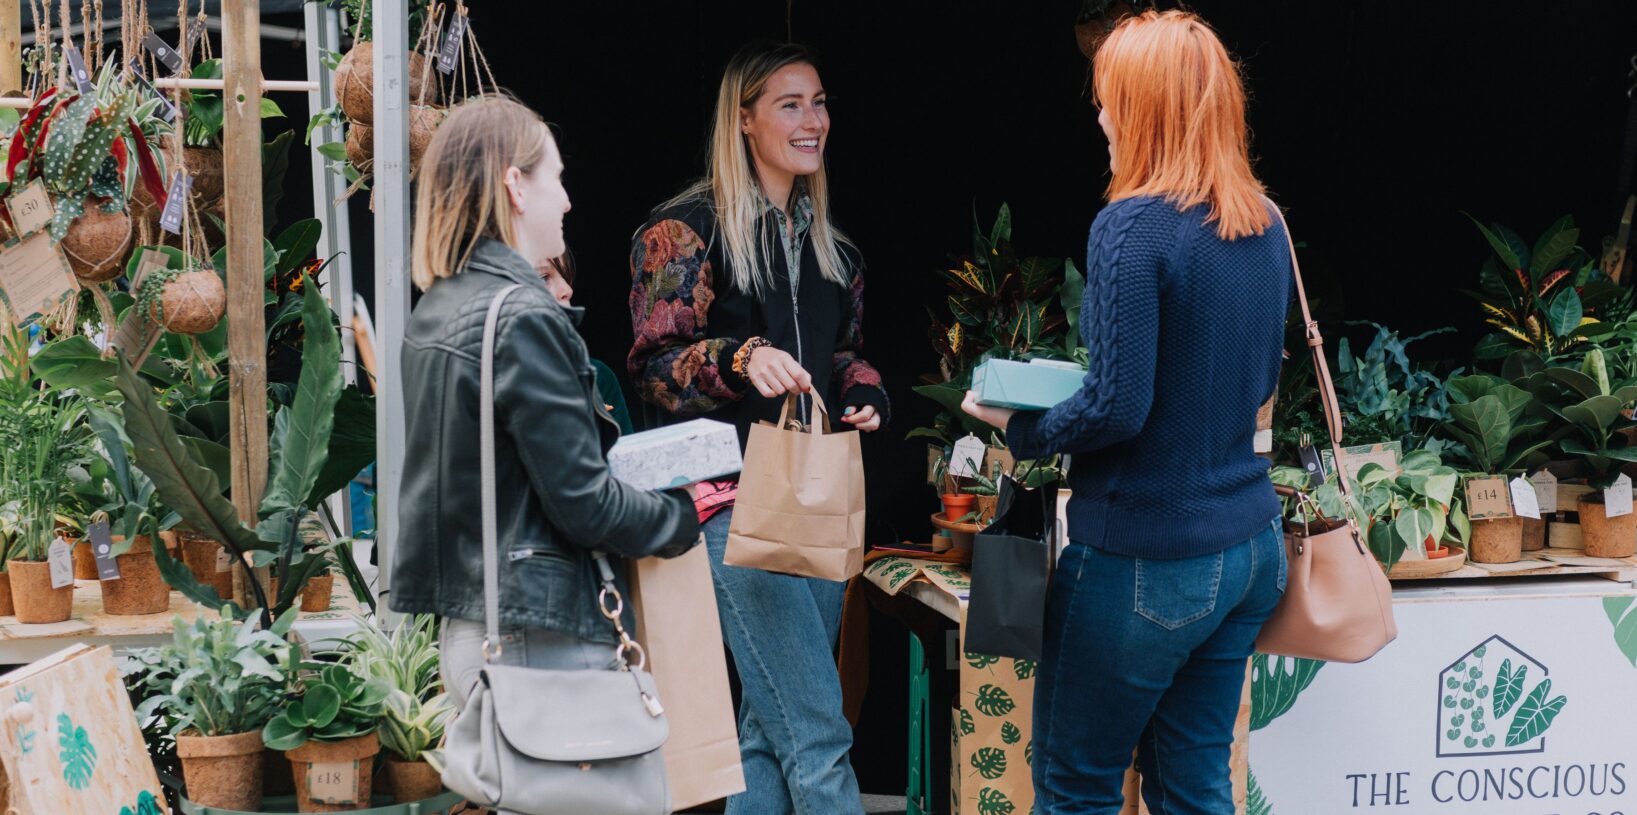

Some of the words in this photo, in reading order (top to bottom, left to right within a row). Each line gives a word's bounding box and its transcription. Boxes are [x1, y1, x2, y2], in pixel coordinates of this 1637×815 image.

[21, 198, 39, 217] £30
[1477, 489, 1497, 500] £14
[317, 771, 342, 784] £18
[1346, 771, 1410, 807] THE
[1431, 762, 1626, 803] CONSCIOUS
